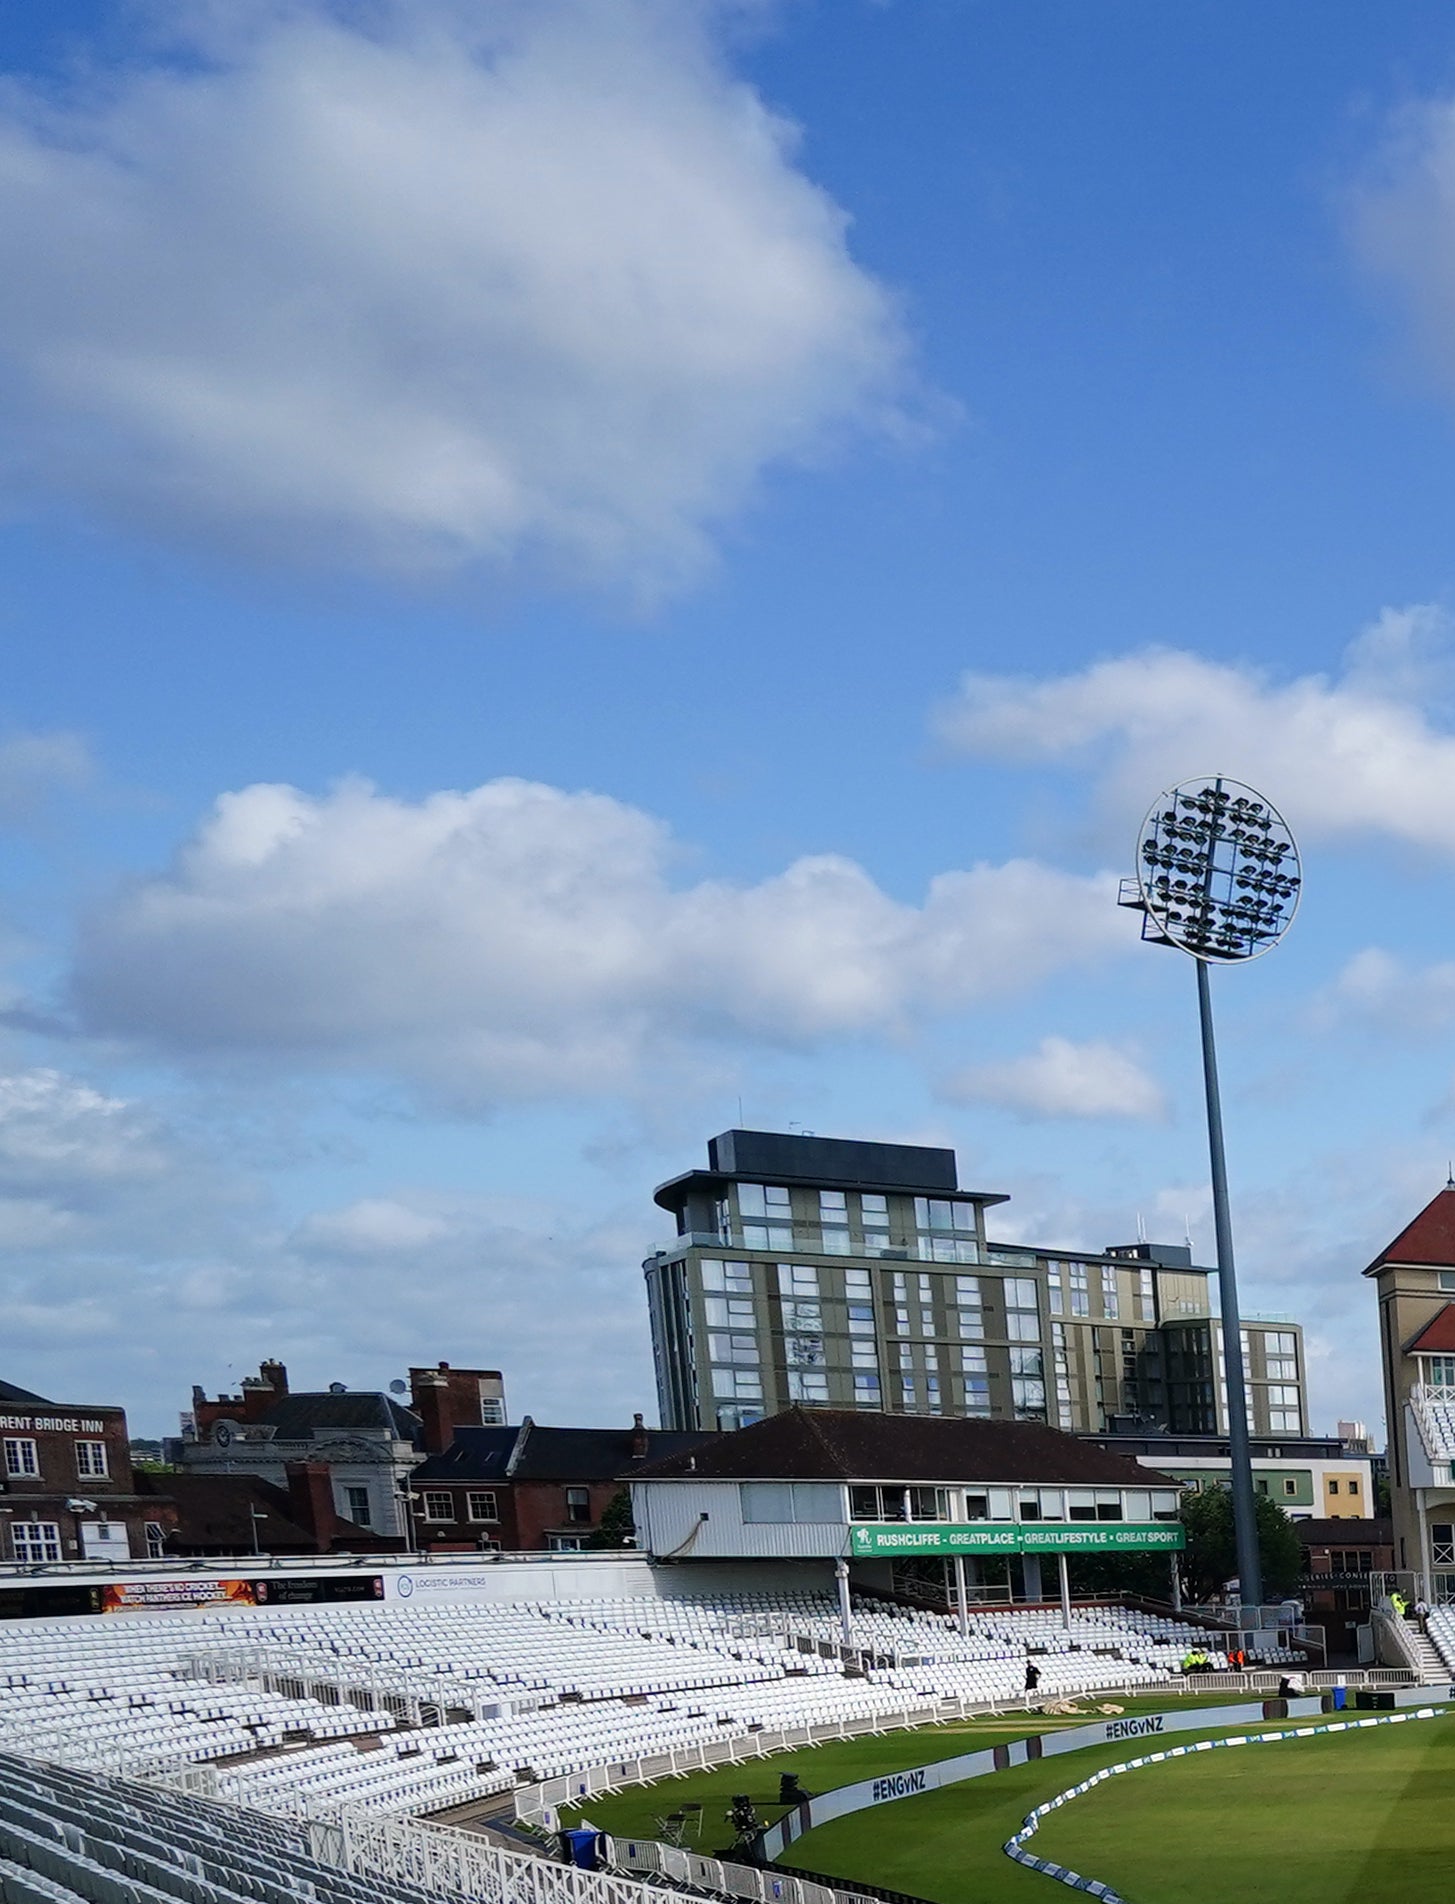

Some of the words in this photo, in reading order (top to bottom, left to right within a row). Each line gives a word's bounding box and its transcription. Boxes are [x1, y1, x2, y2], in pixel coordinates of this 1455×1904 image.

[34, 1417, 79, 1432] BRIDGE
[80, 1419, 104, 1433] INN
[876, 1534, 941, 1547] RUSHCLIFFE
[949, 1532, 1015, 1545] GREATPLACE
[1024, 1532, 1107, 1544] GREATLIFESTYLE
[415, 1579, 448, 1588] LOGISTIC
[449, 1577, 487, 1586] PARTNERS
[1105, 1715, 1164, 1740] #ENGvNZ
[872, 1769, 926, 1801] #ENGvNZ
